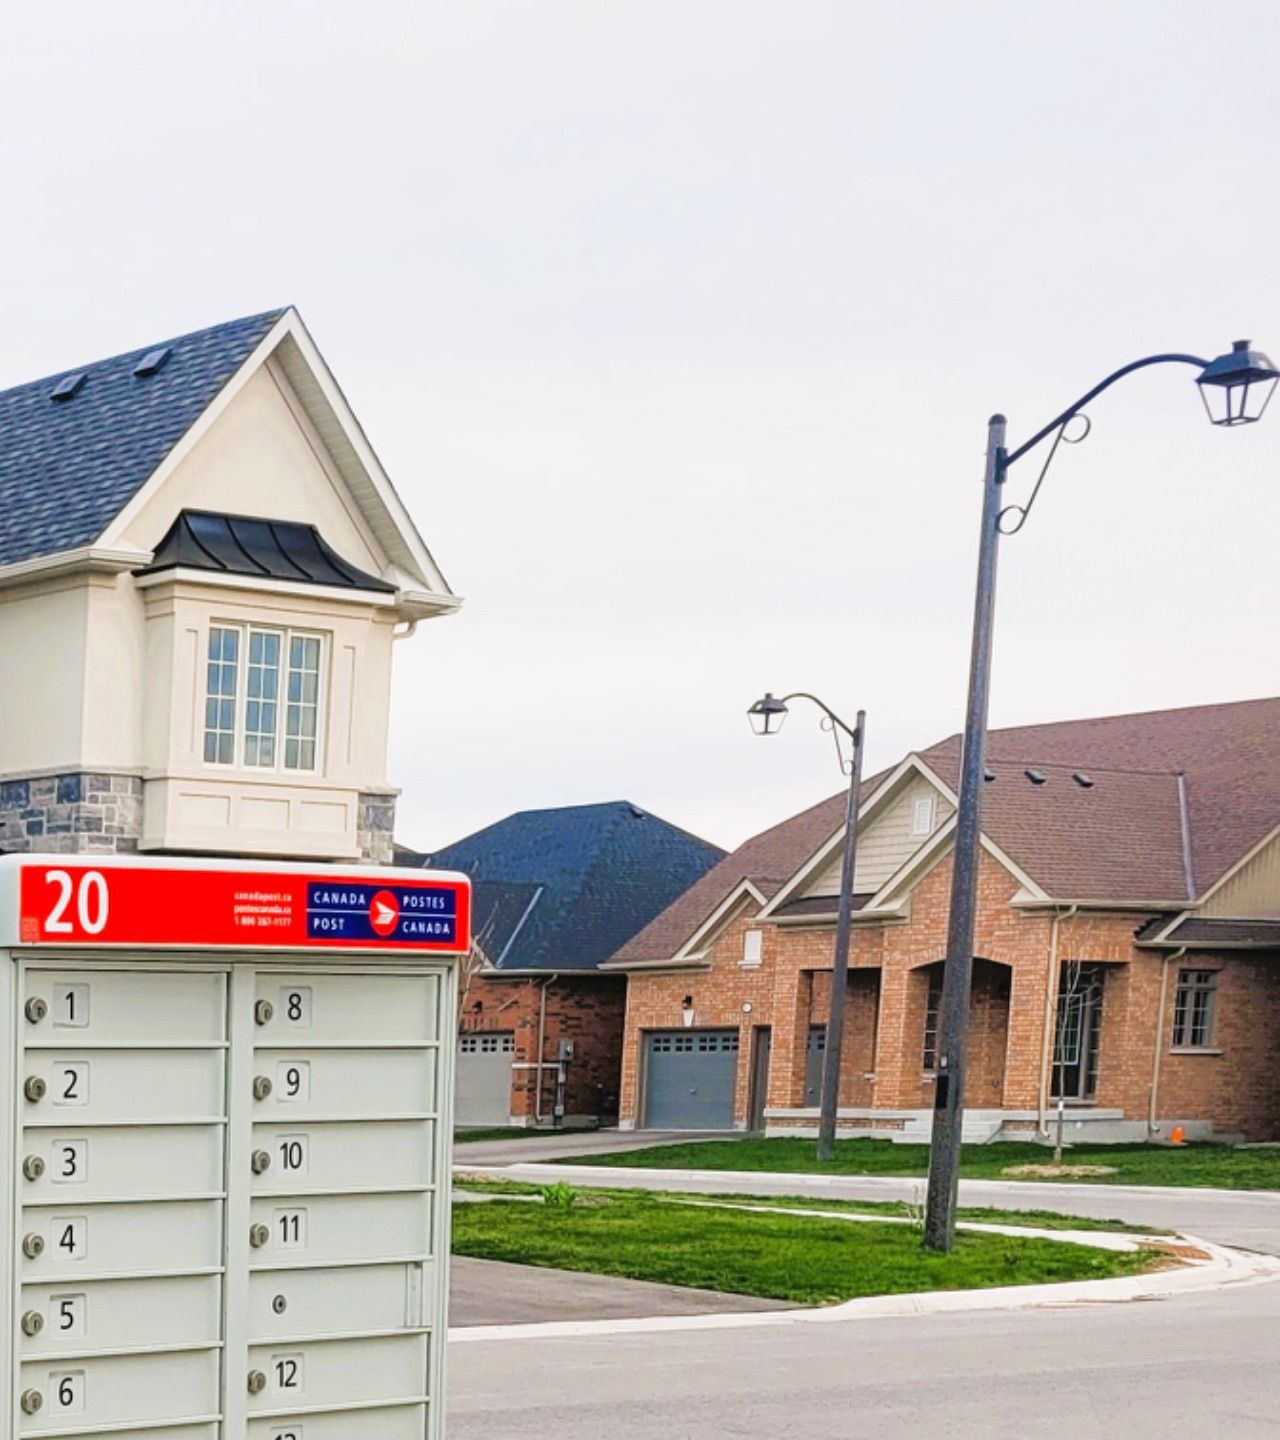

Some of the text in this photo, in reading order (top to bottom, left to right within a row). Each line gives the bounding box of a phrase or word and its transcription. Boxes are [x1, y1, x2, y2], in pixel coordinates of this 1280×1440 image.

[44, 870, 109, 934] 20
[314, 892, 366, 905] CANADA
[403, 896, 444, 909] POSTES
[314, 918, 344, 930] POST
[403, 922, 450, 934] CANADA
[66, 992, 73, 1019] 1
[288, 993, 301, 1020] 8
[64, 1070, 77, 1098] 2
[287, 1068, 299, 1095] 9
[63, 1148, 75, 1176] 3
[281, 1142, 302, 1169] 10
[60, 1225, 75, 1252] 4
[280, 1215, 298, 1242] 11
[61, 1301, 73, 1329] 5
[276, 1360, 296, 1387] 12
[59, 1377, 73, 1406] 6
